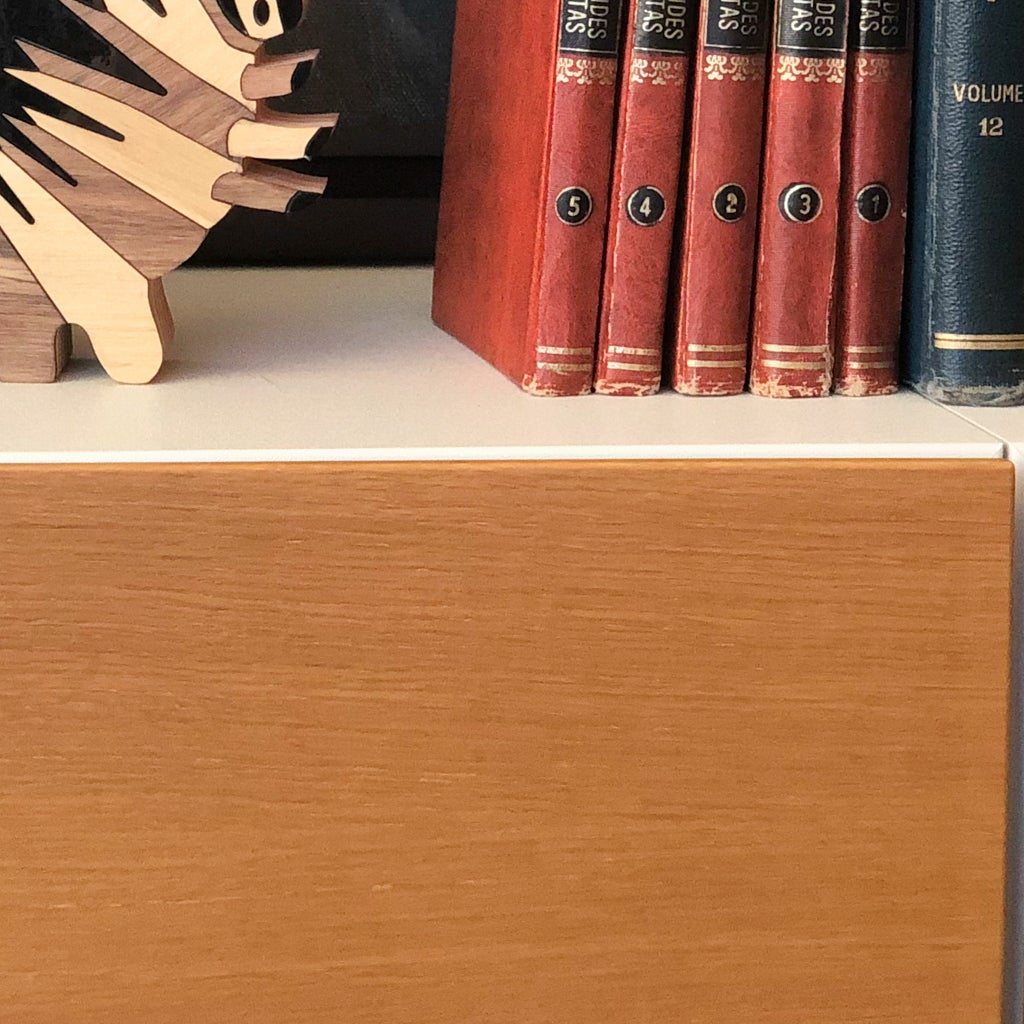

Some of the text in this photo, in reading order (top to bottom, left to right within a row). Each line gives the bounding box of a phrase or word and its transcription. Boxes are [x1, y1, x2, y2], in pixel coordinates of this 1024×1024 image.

[953, 81, 1024, 103] VOLUME
[978, 117, 1004, 136] 12
[567, 195, 581, 217] 5
[639, 196, 651, 218] 4
[726, 192, 738, 214] 2
[799, 193, 811, 215] 3
[871, 194, 880, 214] 1
